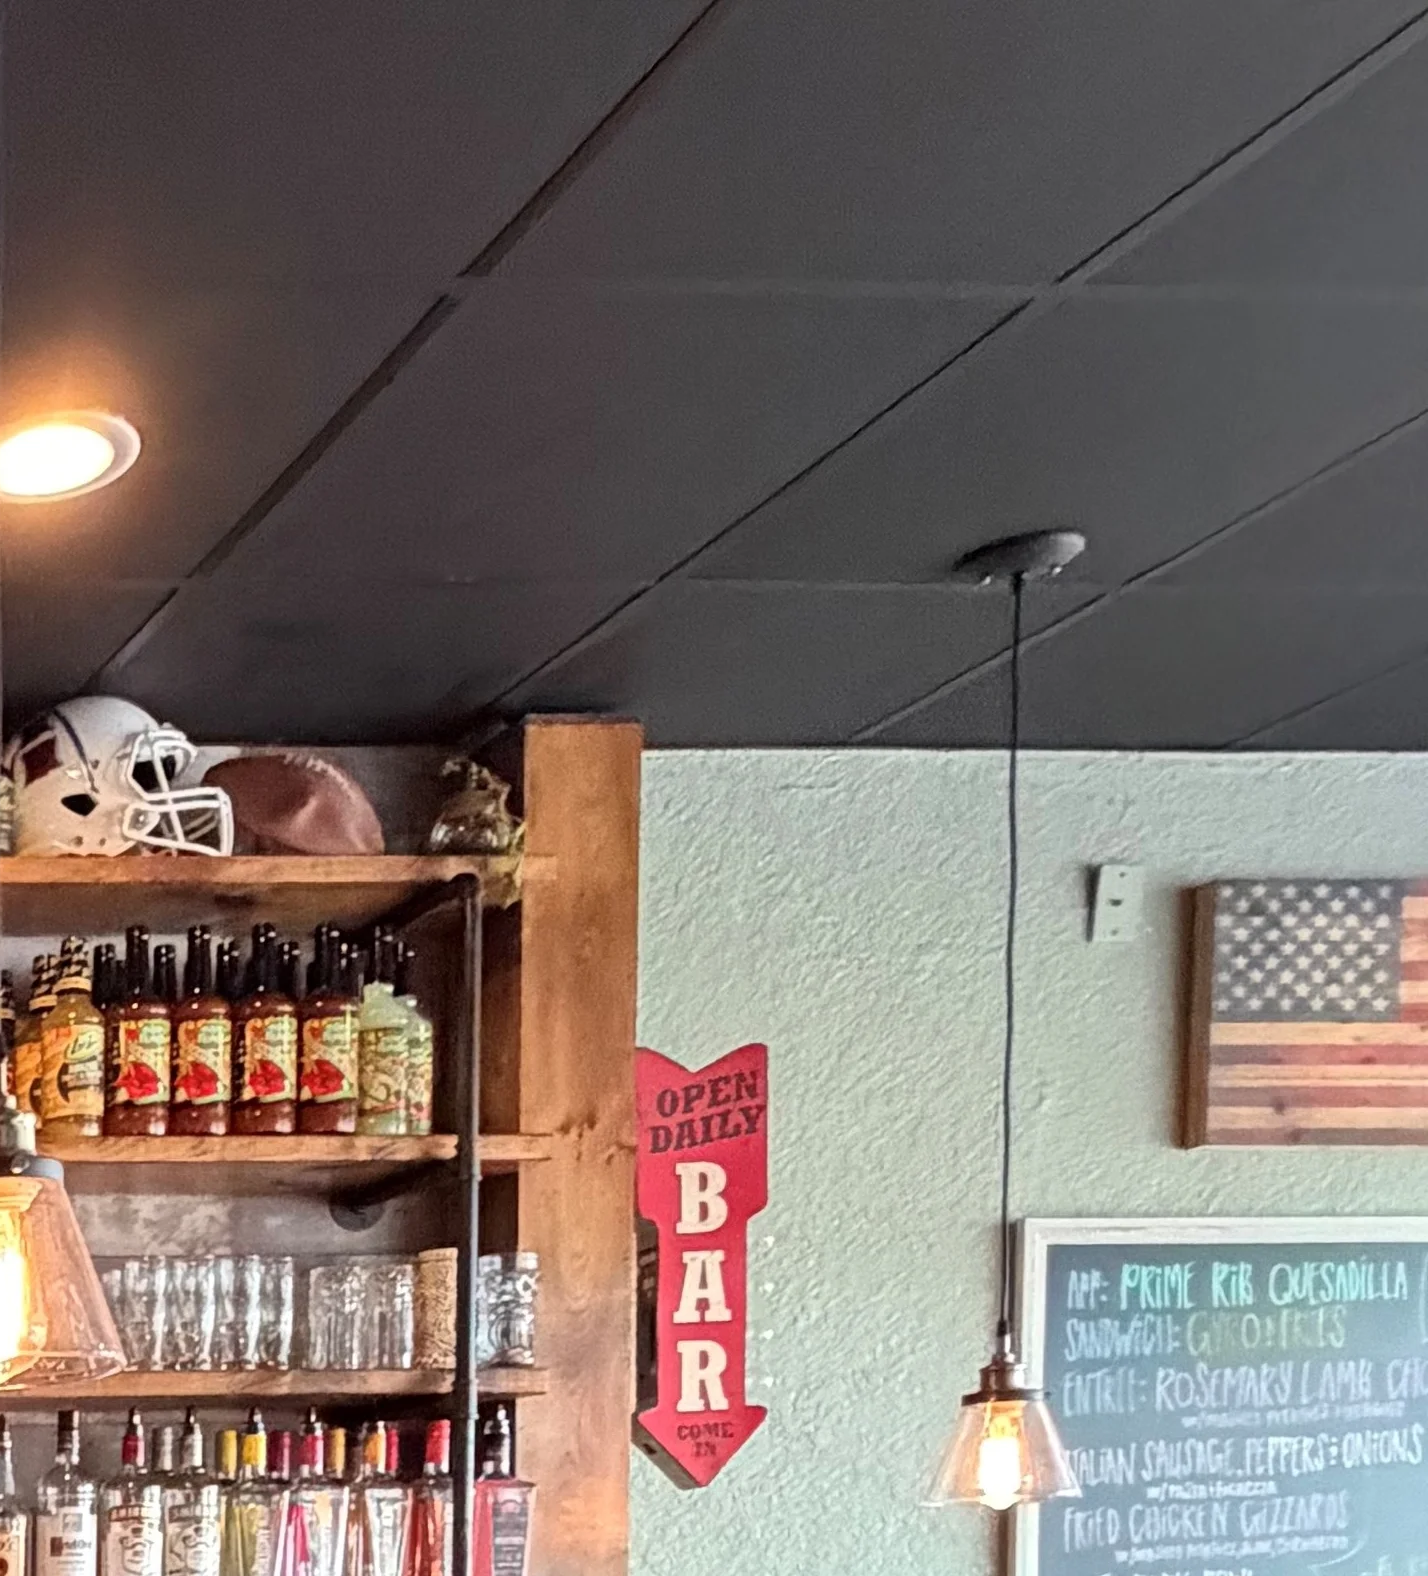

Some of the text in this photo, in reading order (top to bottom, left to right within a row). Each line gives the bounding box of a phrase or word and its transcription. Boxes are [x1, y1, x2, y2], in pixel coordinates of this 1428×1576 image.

[656, 1070, 760, 1118] OPEN
[649, 1104, 767, 1154] DAILY
[673, 1161, 732, 1413] BAR
[676, 1422, 734, 1440] COME
